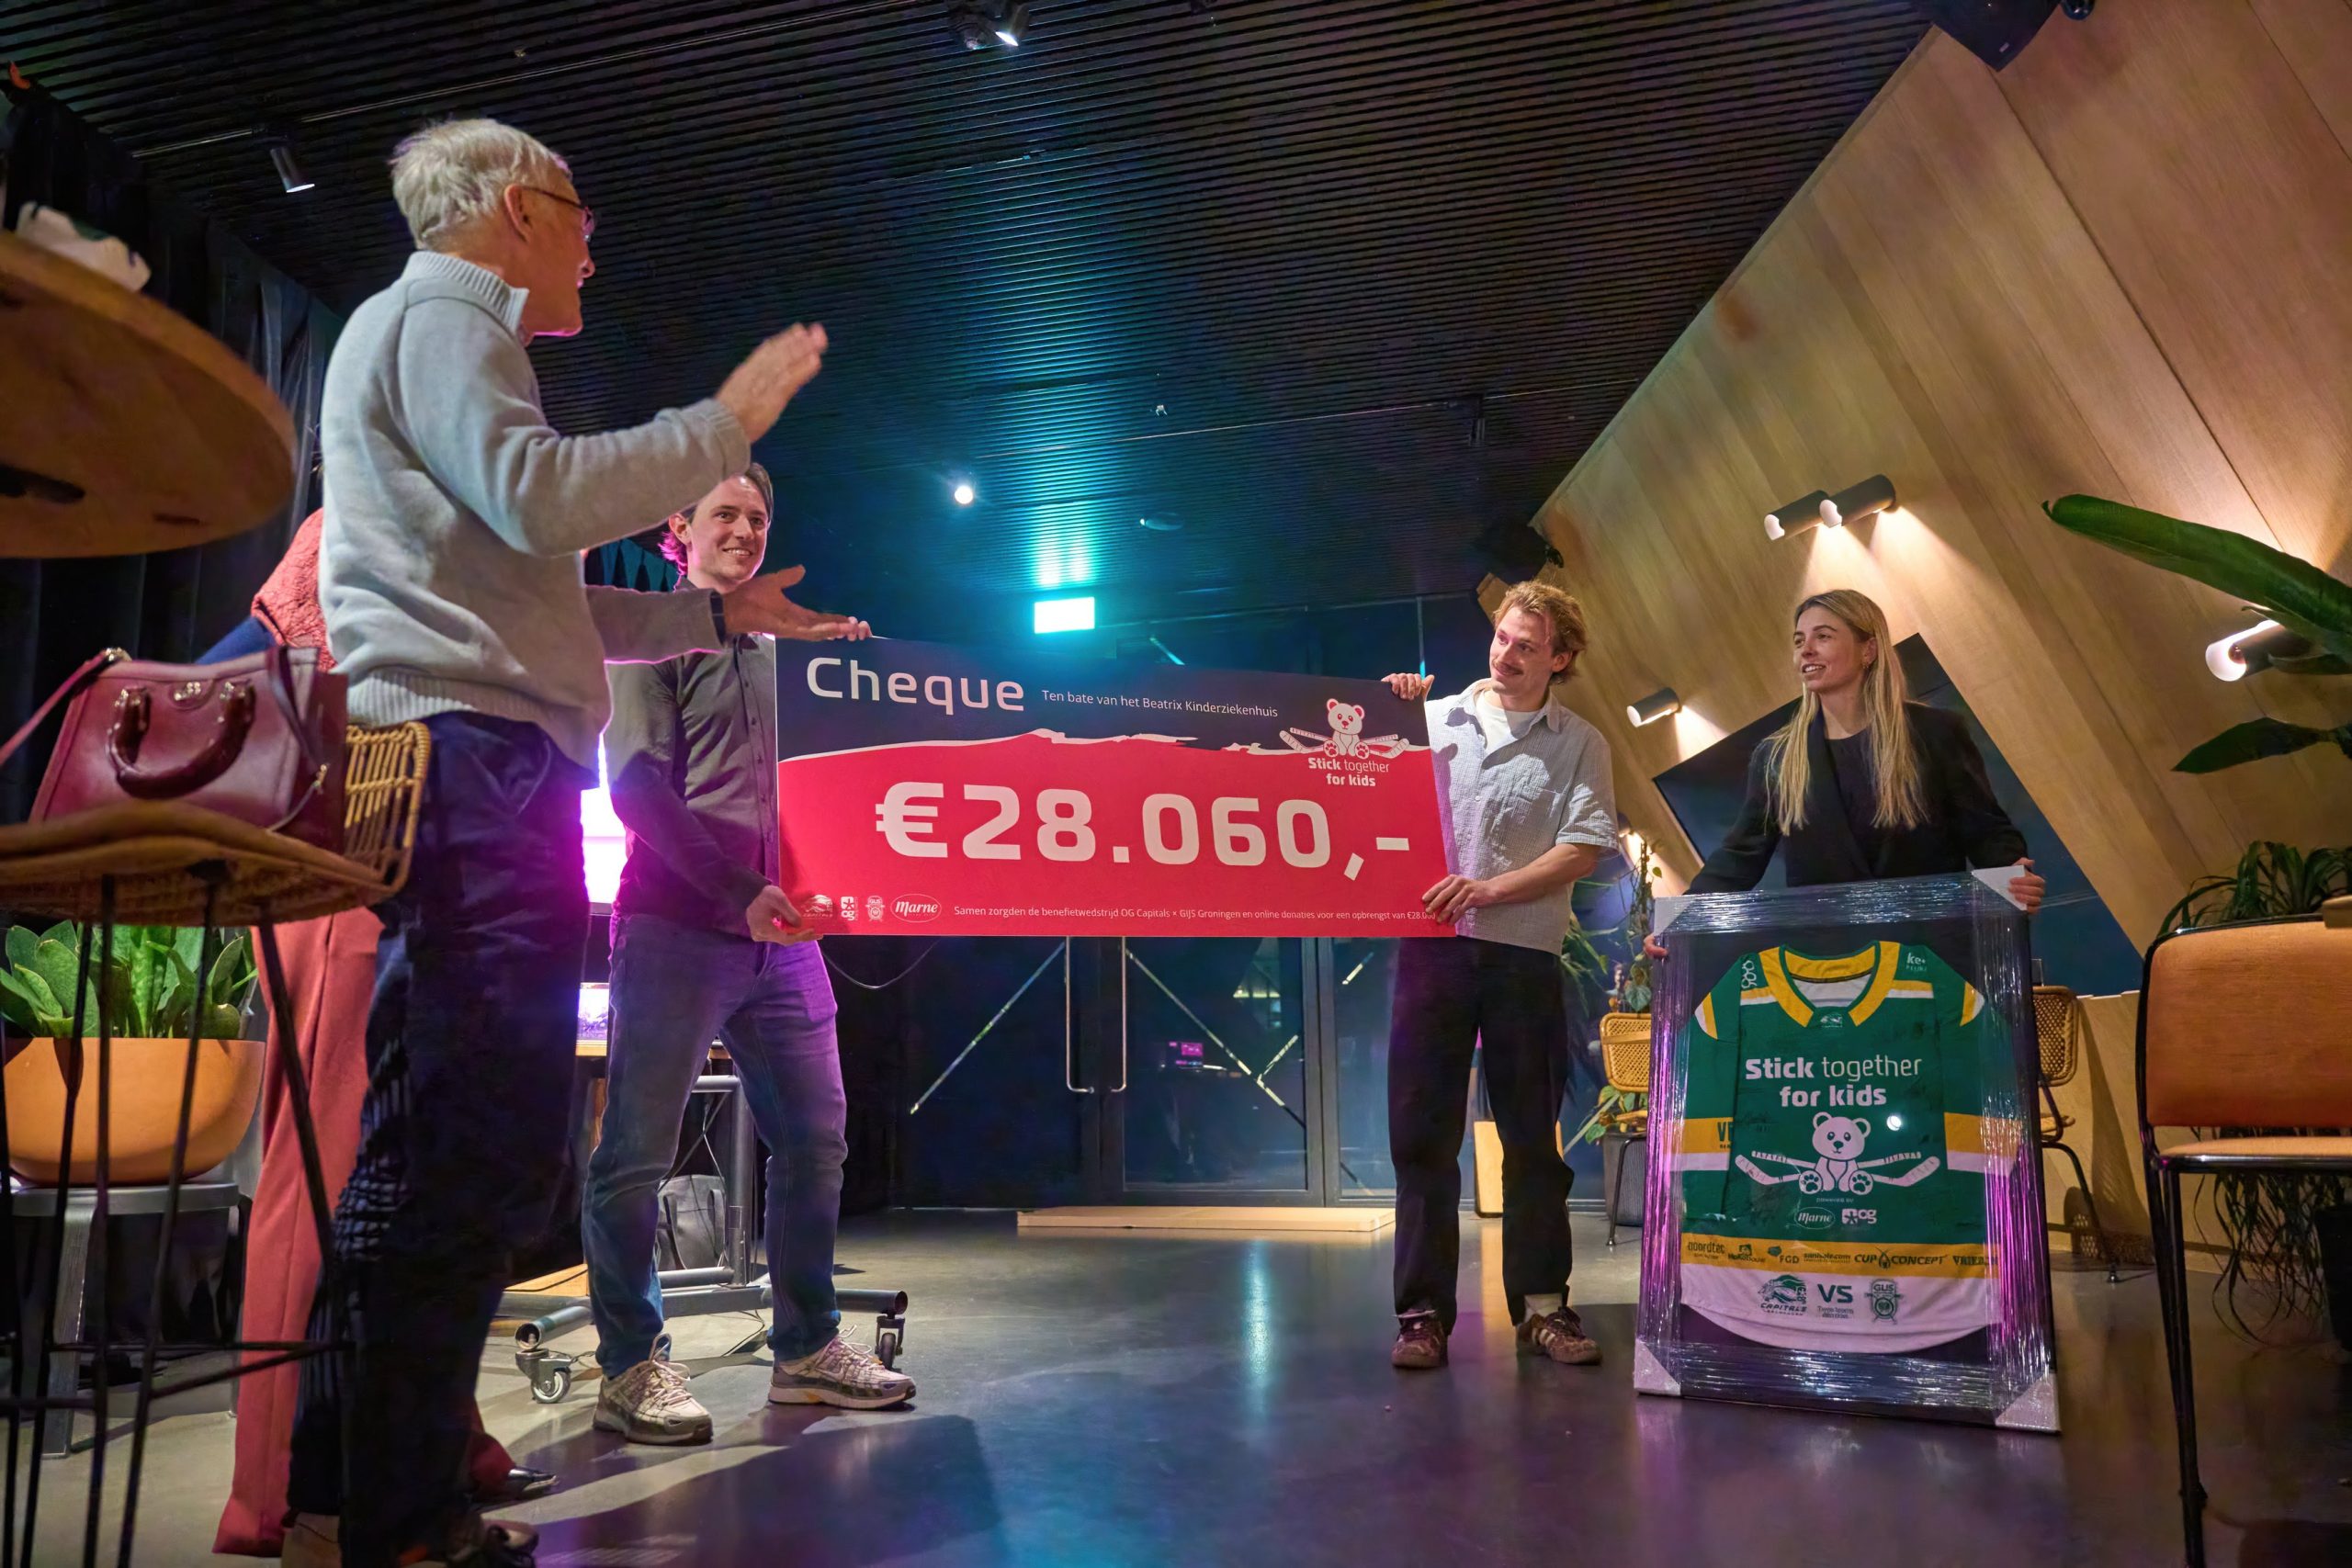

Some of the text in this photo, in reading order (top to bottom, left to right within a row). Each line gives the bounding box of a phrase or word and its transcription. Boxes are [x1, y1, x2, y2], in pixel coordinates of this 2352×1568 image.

[807, 657, 1024, 715] Cheque
[1042, 690, 1278, 717] Ten bate van het Beatrix Kinderziekenhuis
[1307, 757, 1390, 773] Stick together
[1326, 773, 1376, 787] for kids
[875, 781, 1409, 881] €28.060,-
[895, 901, 938, 917] Marne
[954, 906, 986, 916] Samen
[989, 907, 1026, 918] zorgden
[1028, 907, 1040, 916] de
[1042, 907, 1119, 919] benefietwedstrijd
[1121, 908, 1135, 917] OG
[1136, 908, 1170, 919] Capitals
[1198, 909, 1240, 919] Groningen
[1254, 910, 1279, 919] online
[1352, 911, 1390, 920] opbrengst
[1746, 1055, 1922, 1082] Stick together
[1780, 1084, 1886, 1107] for kids
[1798, 1213, 1832, 1225] Marne
[1854, 1254, 1877, 1264] CUP
[1890, 1255, 1945, 1266] CONCEPT
[1817, 1283, 1854, 1303] VS
